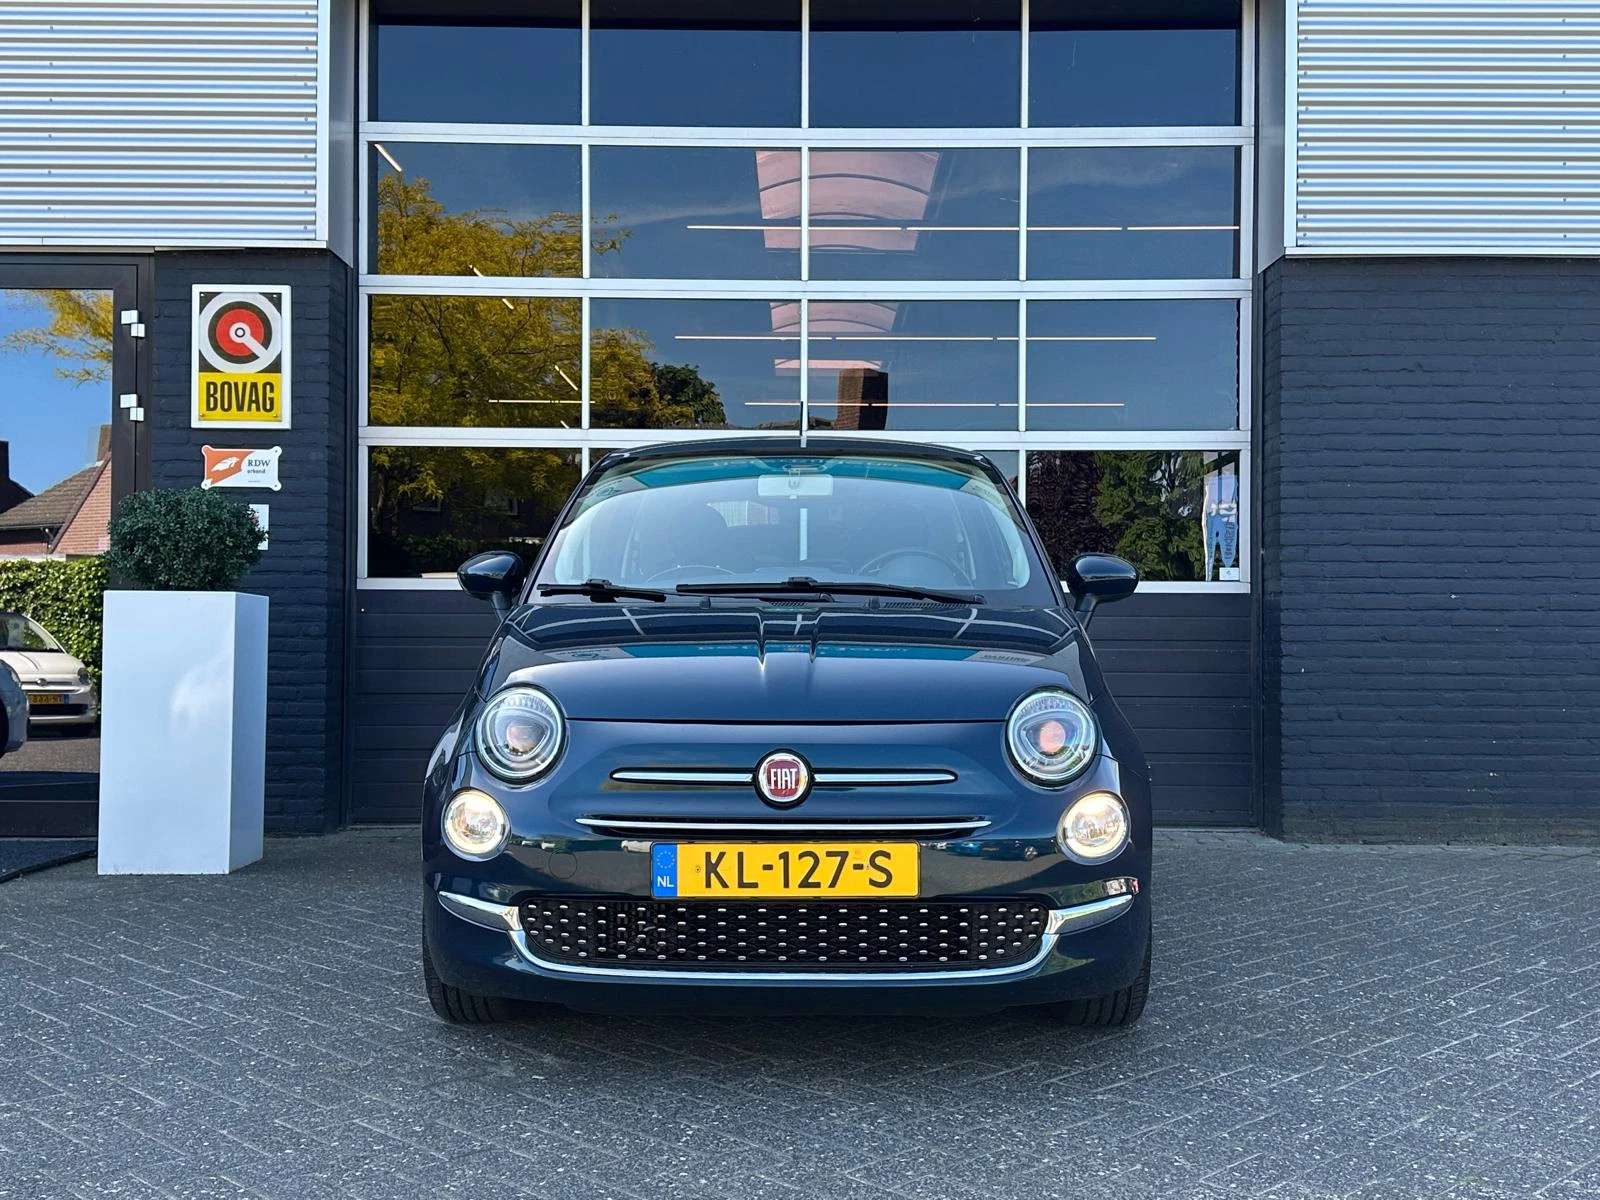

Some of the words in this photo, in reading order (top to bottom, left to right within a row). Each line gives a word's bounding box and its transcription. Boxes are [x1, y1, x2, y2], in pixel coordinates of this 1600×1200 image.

[205, 380, 275, 413] BOVAG
[247, 459, 271, 467] RDW
[770, 768, 797, 790] FIAT
[657, 875, 675, 888] NL
[704, 850, 893, 888] KL-127-S
